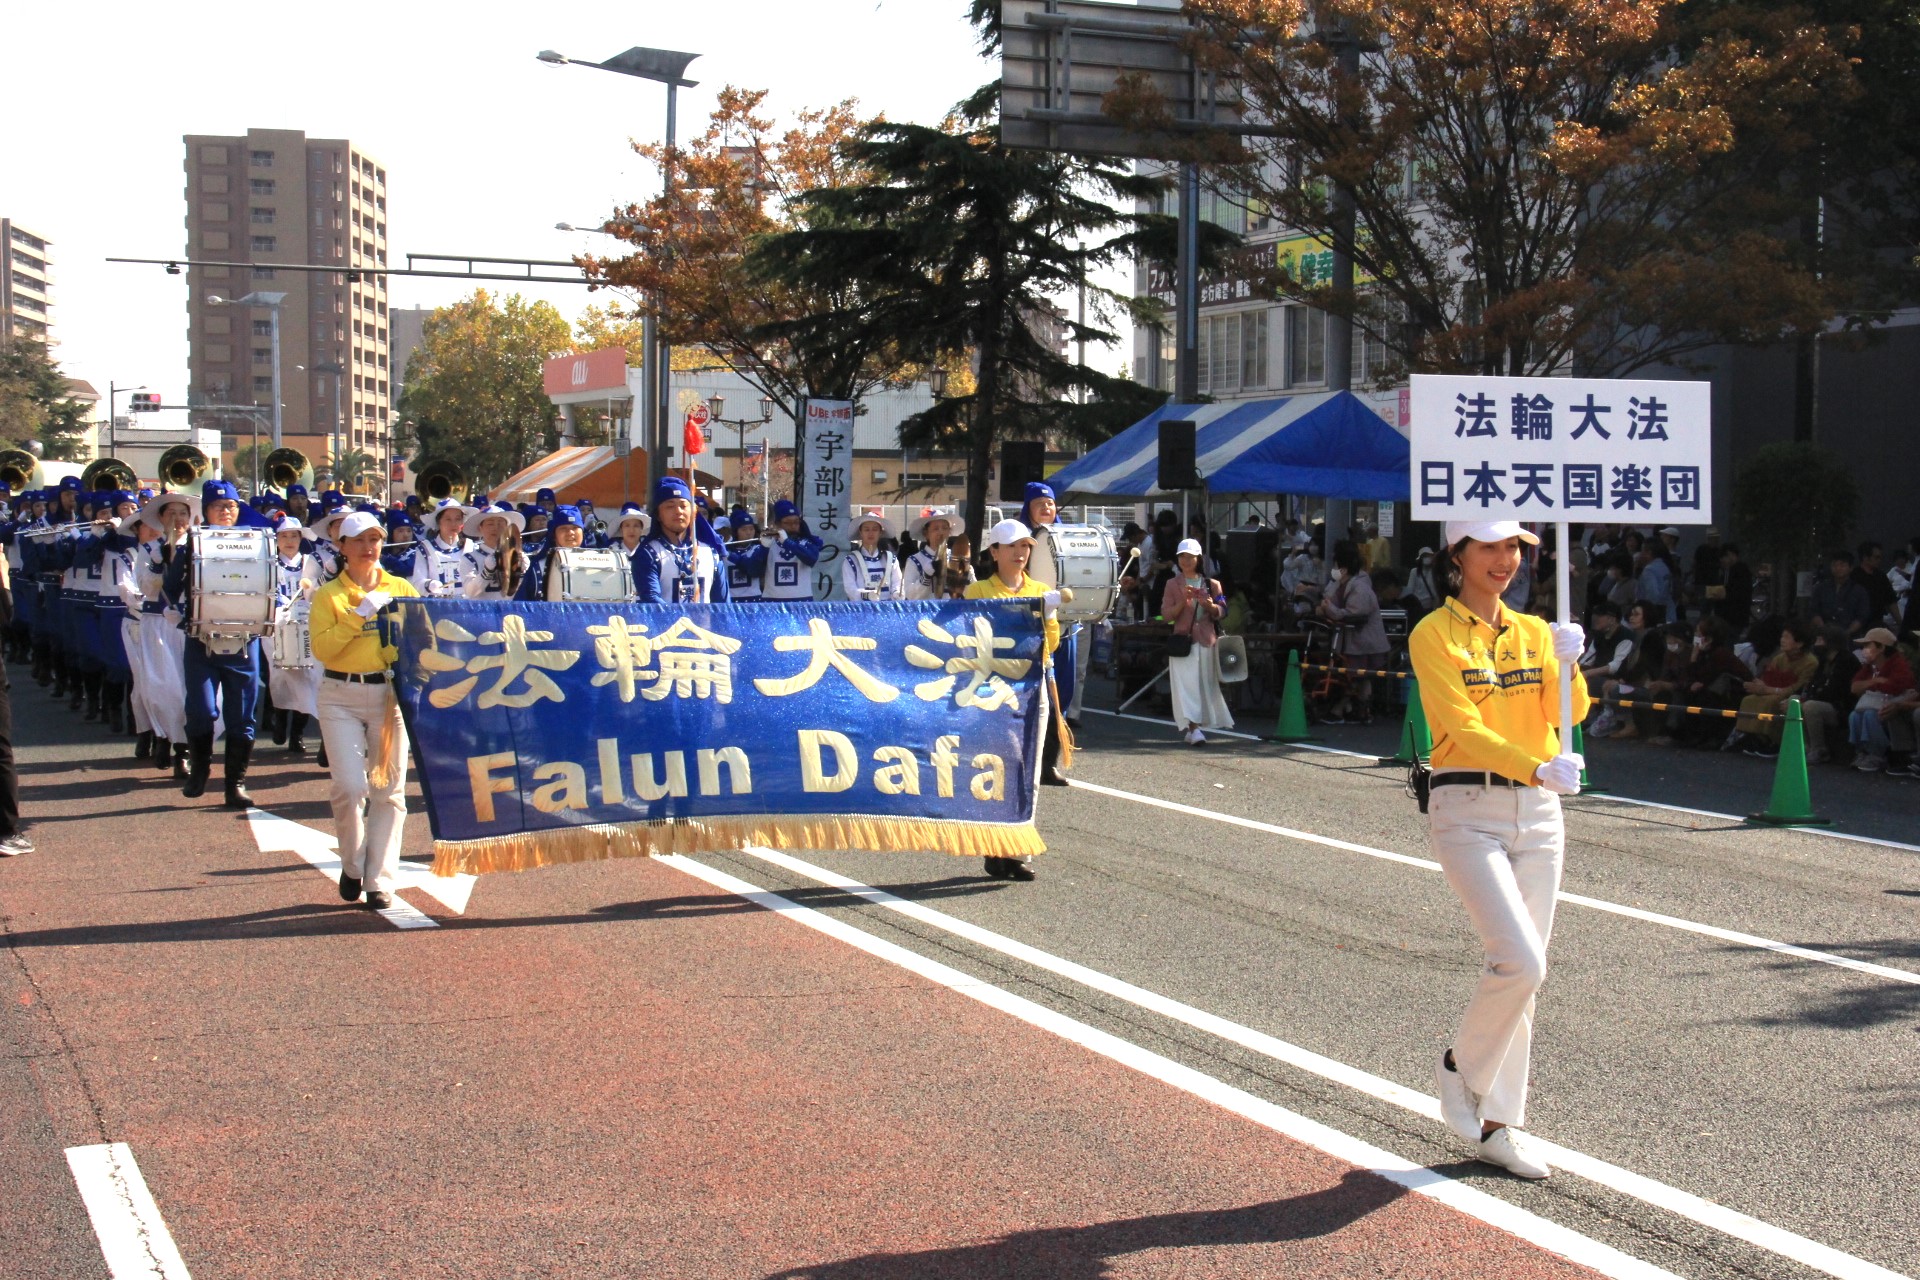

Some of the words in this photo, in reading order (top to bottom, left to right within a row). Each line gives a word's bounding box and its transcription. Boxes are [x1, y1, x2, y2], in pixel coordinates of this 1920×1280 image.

[1454, 392, 1670, 442] 法輪大法
[814, 431, 845, 601] 宇部まつり
[1421, 461, 1700, 511] 日本天国楽団
[419, 613, 1033, 711] 法輪大法
[466, 737, 753, 823] Falun
[797, 729, 1006, 801] Dafa
